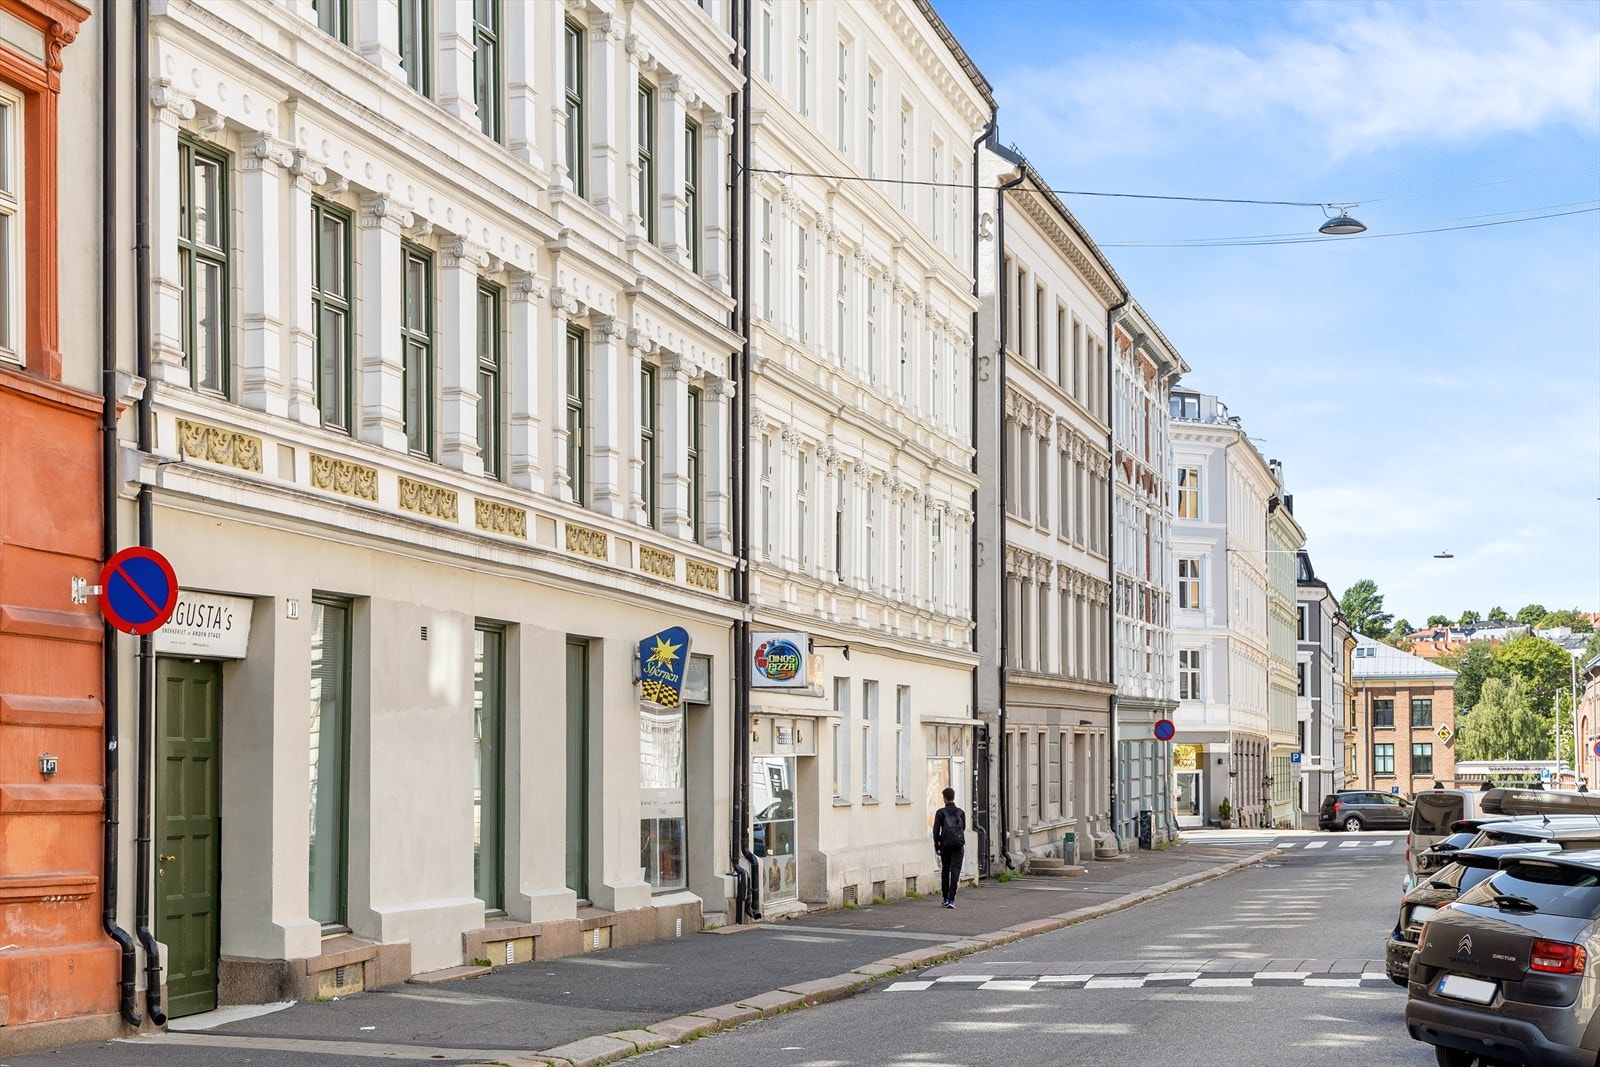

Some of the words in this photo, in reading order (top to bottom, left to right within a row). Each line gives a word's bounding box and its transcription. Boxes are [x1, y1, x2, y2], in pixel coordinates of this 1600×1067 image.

[192, 630, 207, 638] ANDEN
[769, 654, 795, 663] DINOS
[769, 662, 795, 671] PIZZA
[643, 661, 679, 683] Stjernen
[1292, 753, 1299, 762] P
[1492, 953, 1516, 962] CACTUS
